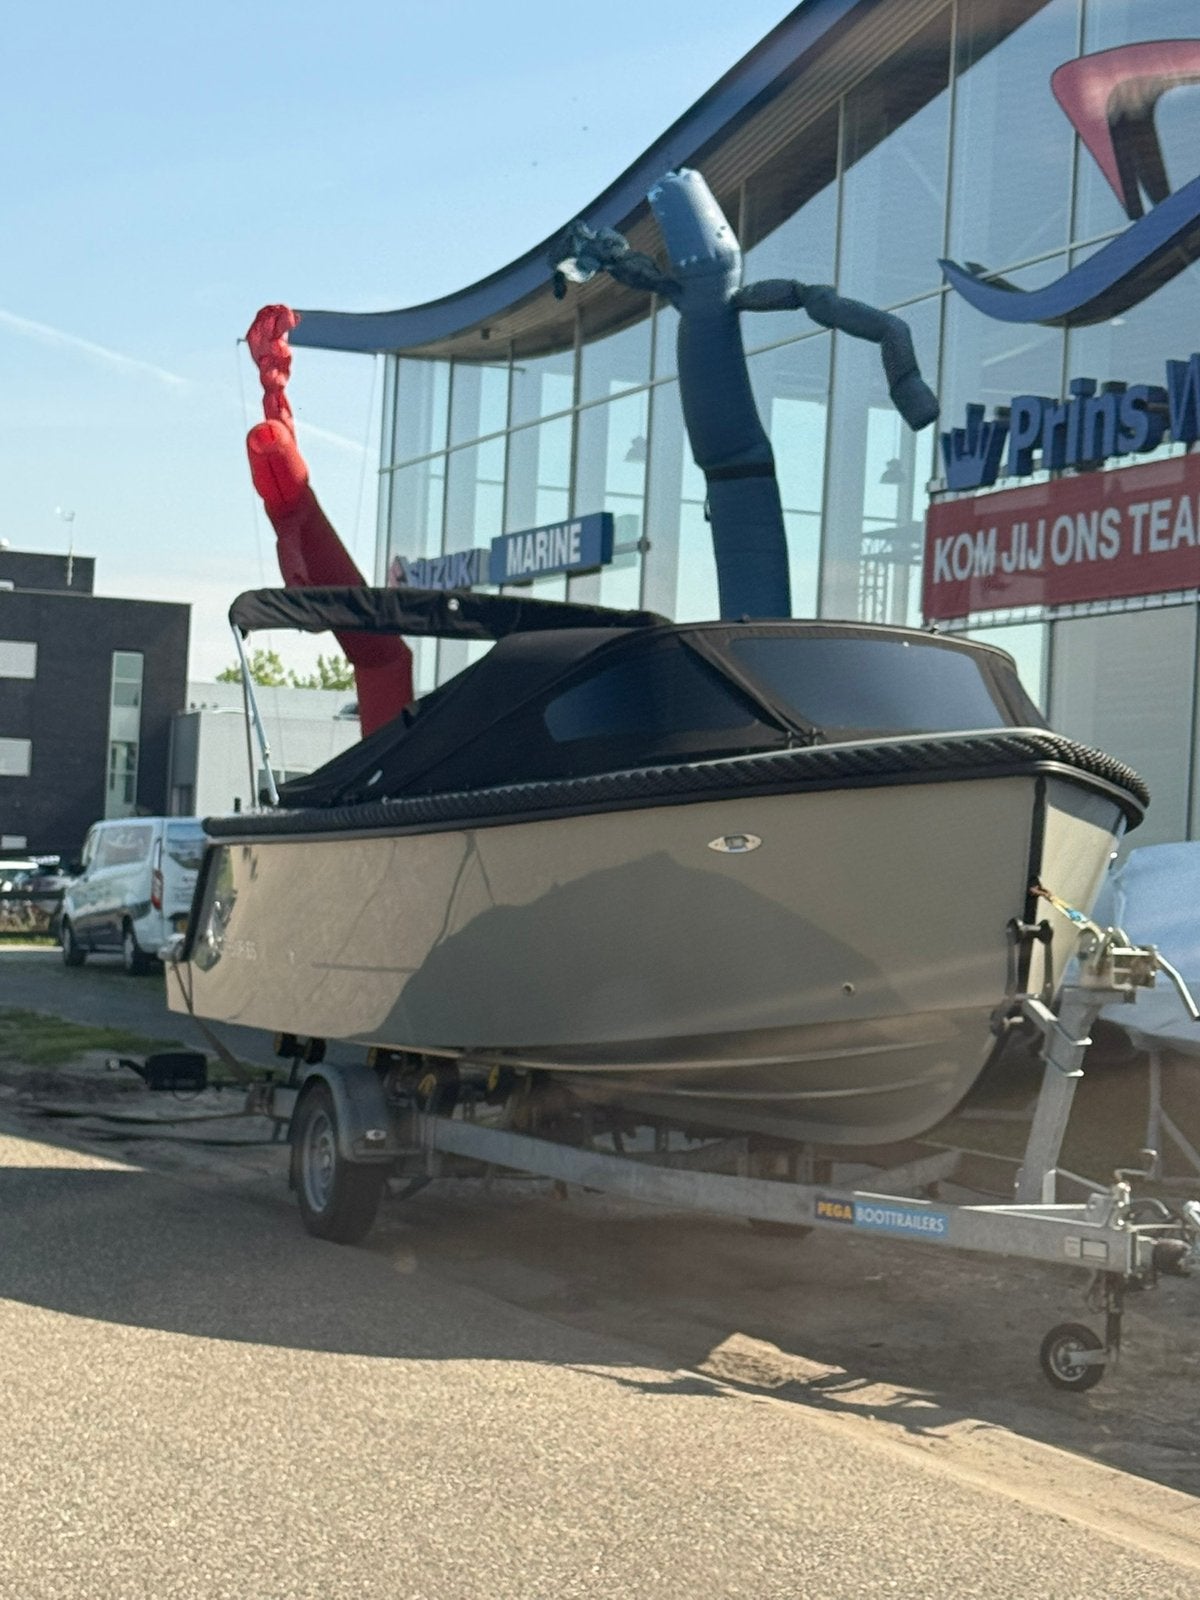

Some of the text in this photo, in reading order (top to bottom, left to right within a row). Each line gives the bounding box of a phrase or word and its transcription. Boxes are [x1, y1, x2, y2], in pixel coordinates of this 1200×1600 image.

[1008, 377, 1162, 477] Prins
[507, 523, 581, 576] MARINE
[933, 494, 1200, 584] KOM JIJ ONS TEA
[818, 1202, 944, 1232] PEGA BOOTTRAILERS
